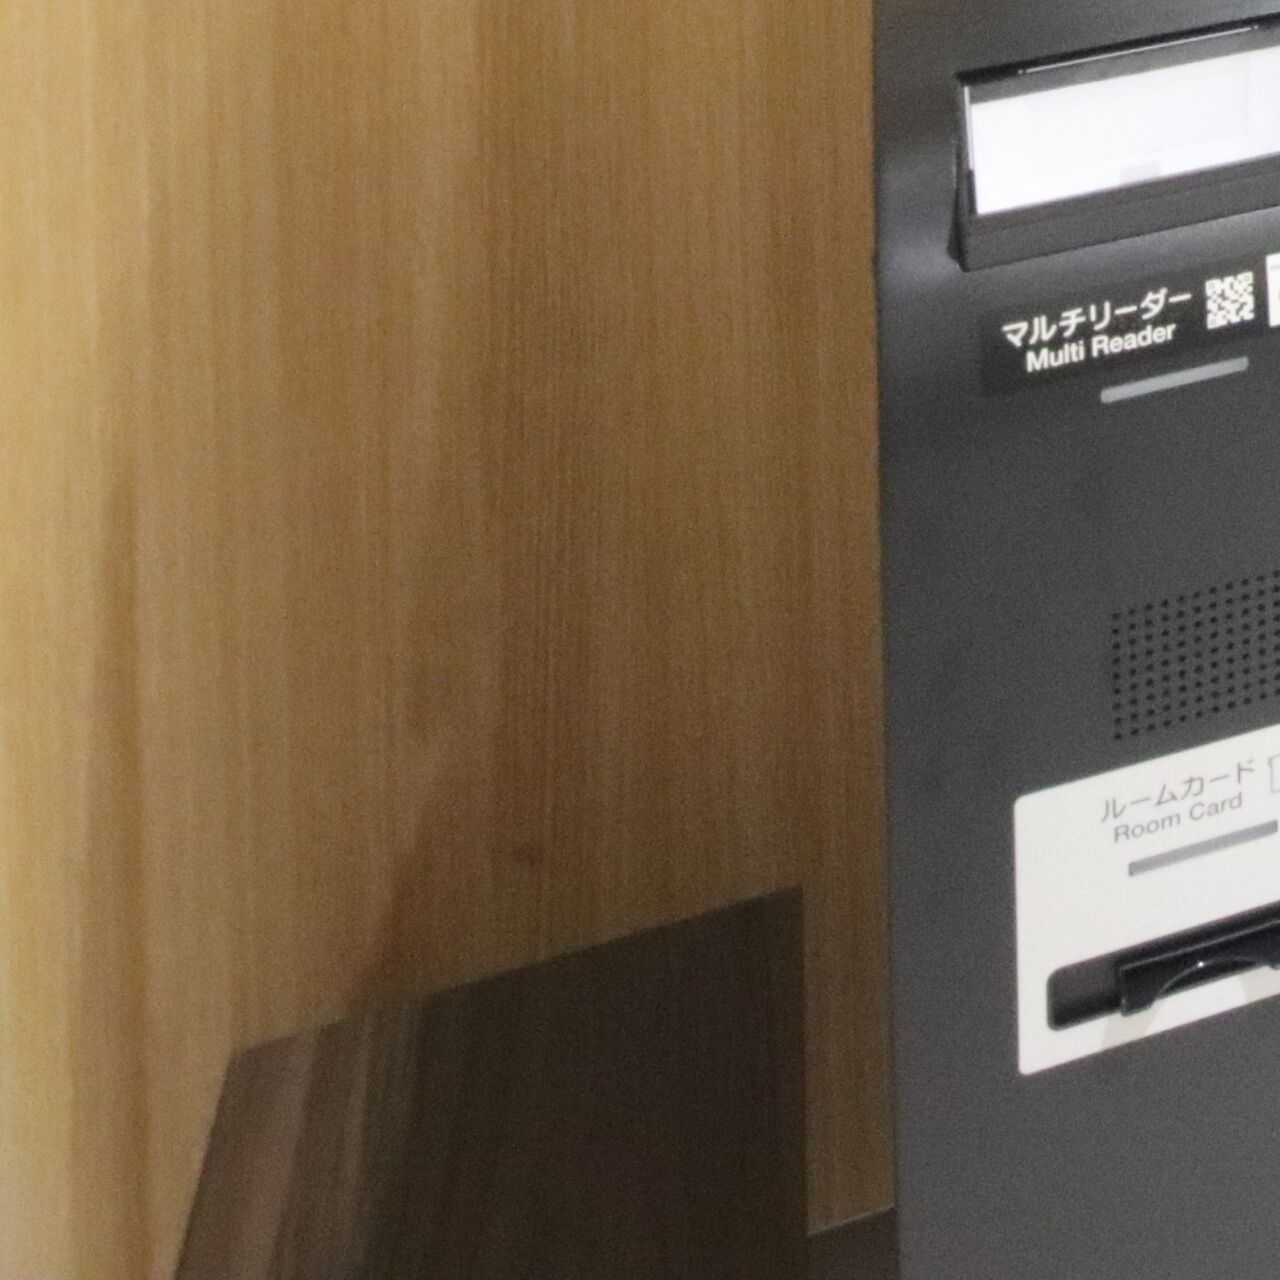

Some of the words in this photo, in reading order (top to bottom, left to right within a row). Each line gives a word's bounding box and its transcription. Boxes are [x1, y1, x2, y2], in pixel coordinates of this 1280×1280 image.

[1002, 287, 1193, 348] マルチリーダー
[1026, 340, 1086, 373] Multi
[1092, 323, 1177, 358] Reader
[1101, 758, 1257, 823] ルームカード
[1113, 811, 1182, 844] Room
[1189, 791, 1244, 822] Card
